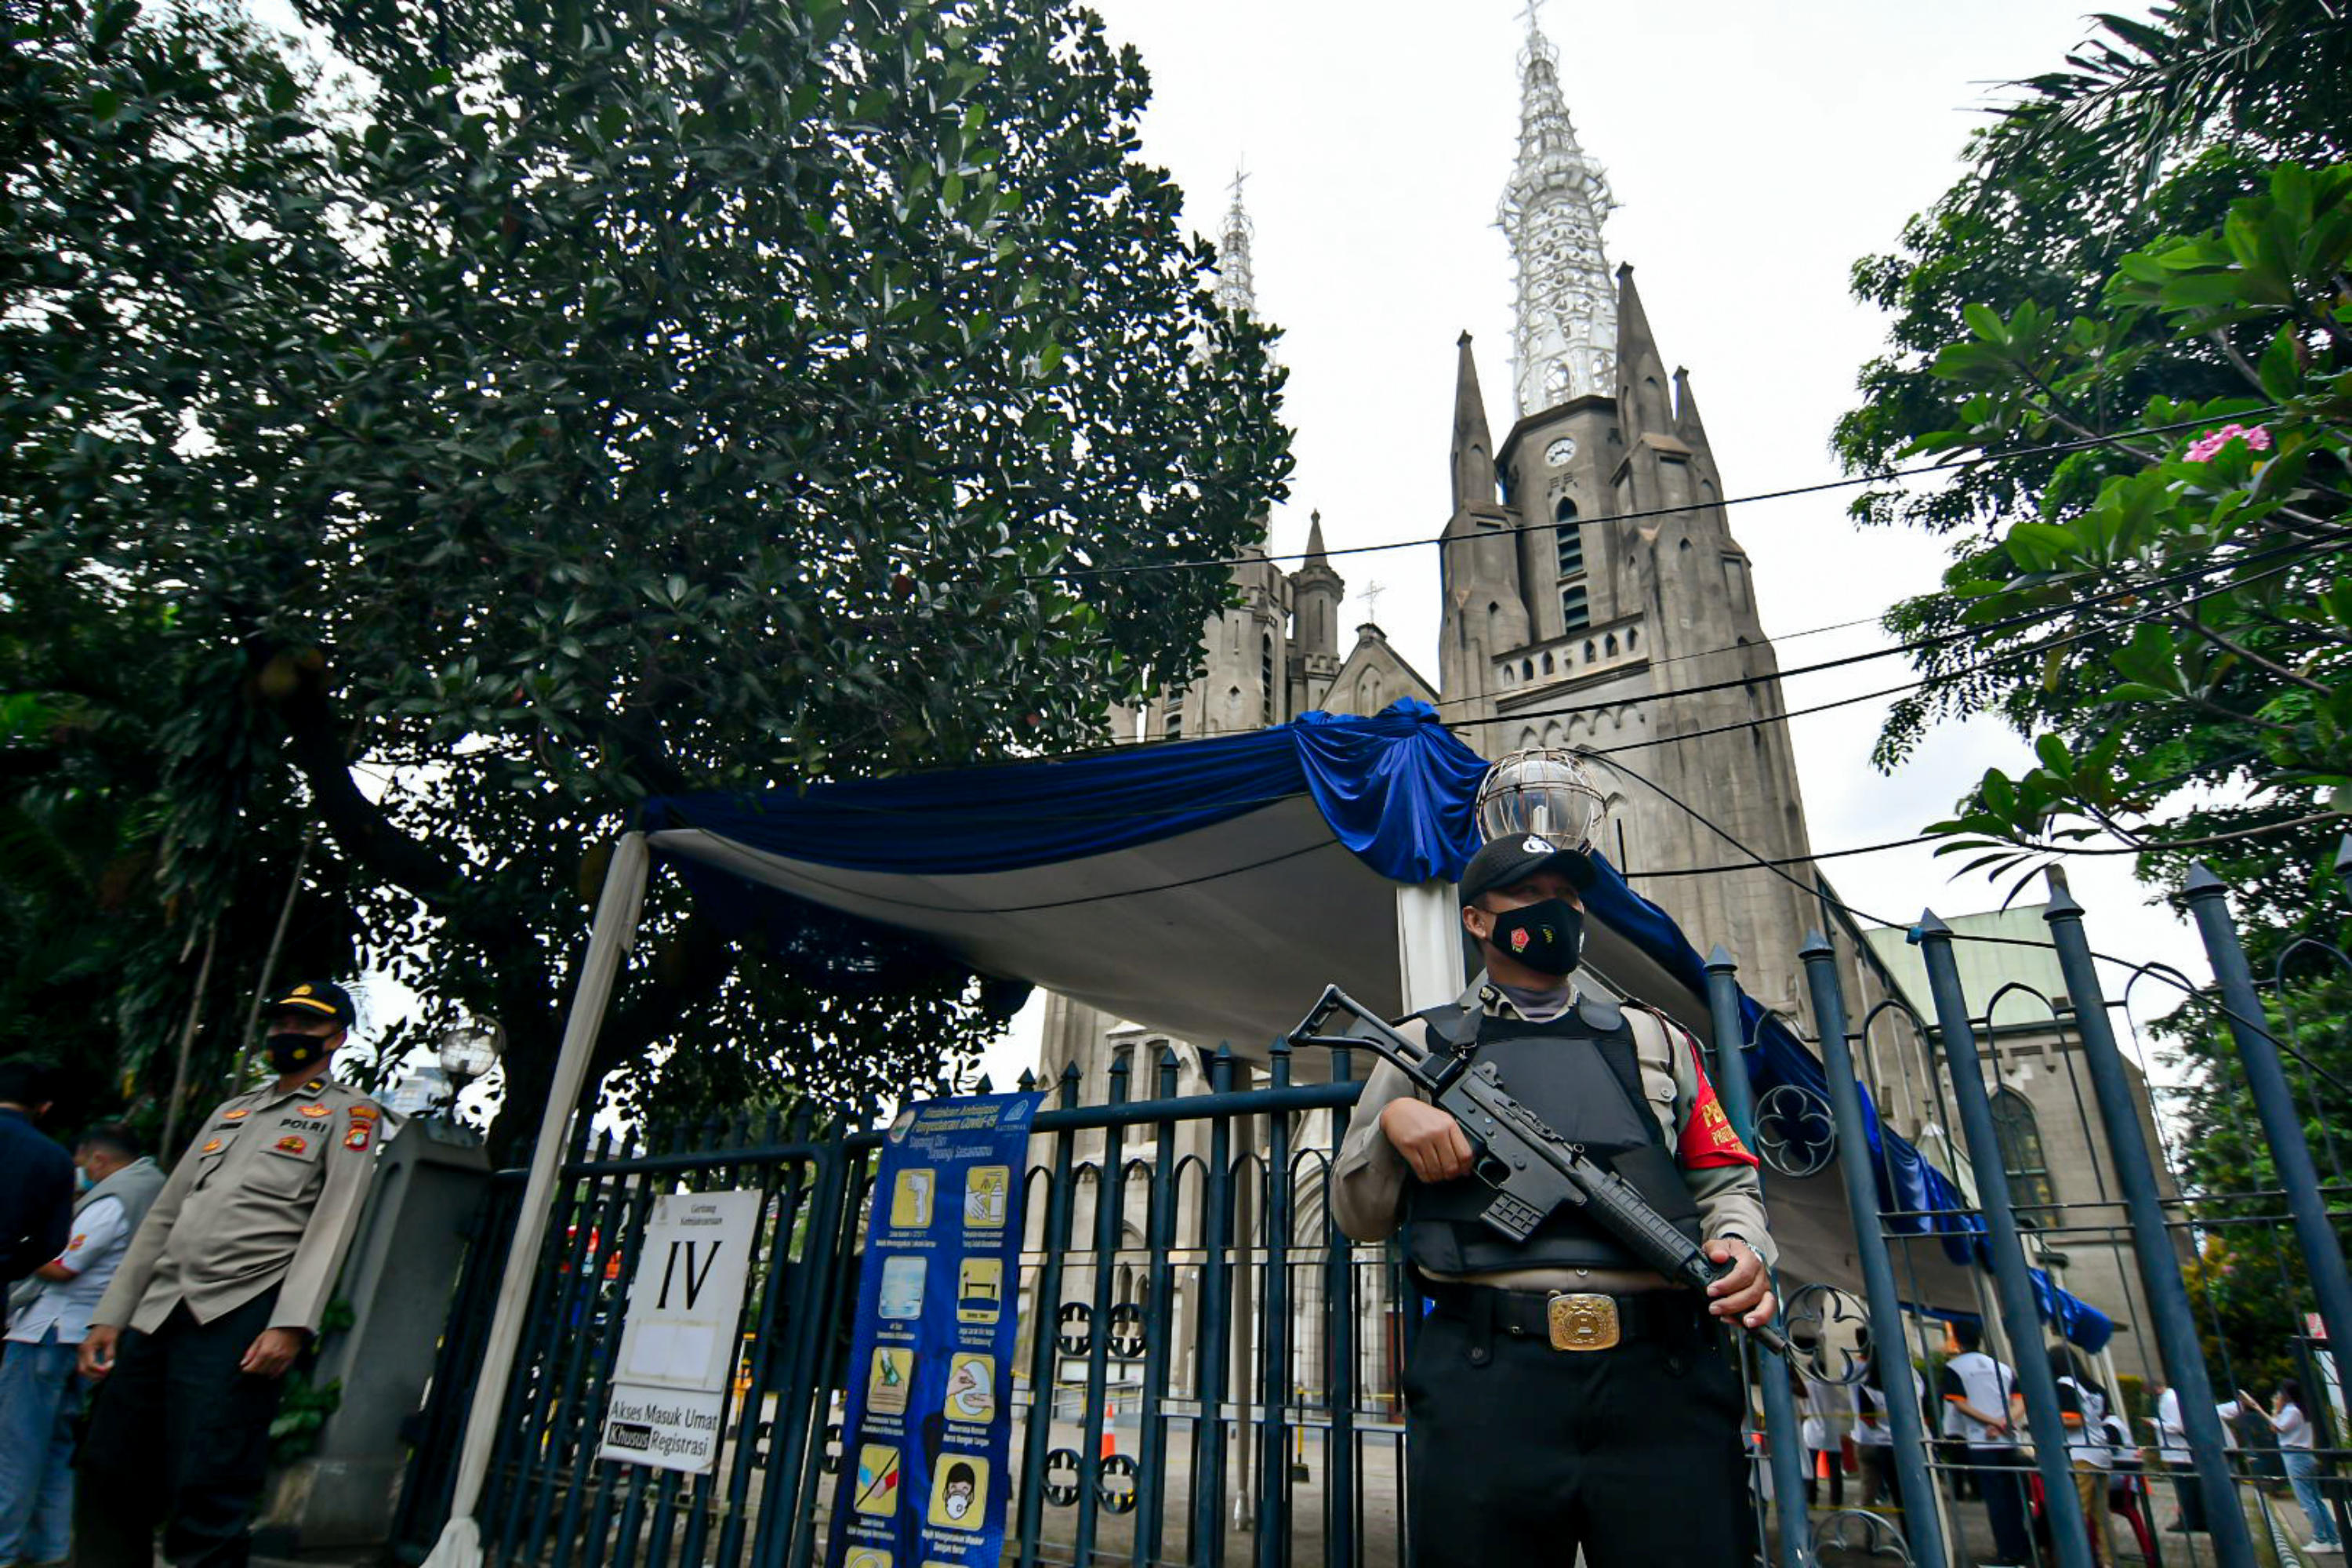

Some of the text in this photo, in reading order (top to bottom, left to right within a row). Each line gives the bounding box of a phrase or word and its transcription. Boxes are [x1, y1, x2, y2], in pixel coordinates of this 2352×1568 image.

[279, 1118, 327, 1133] POLRI
[656, 1240, 723, 1310] IV
[610, 1400, 718, 1430] Akses Masuk Umat
[608, 1424, 710, 1456] Khusus Registrasi
